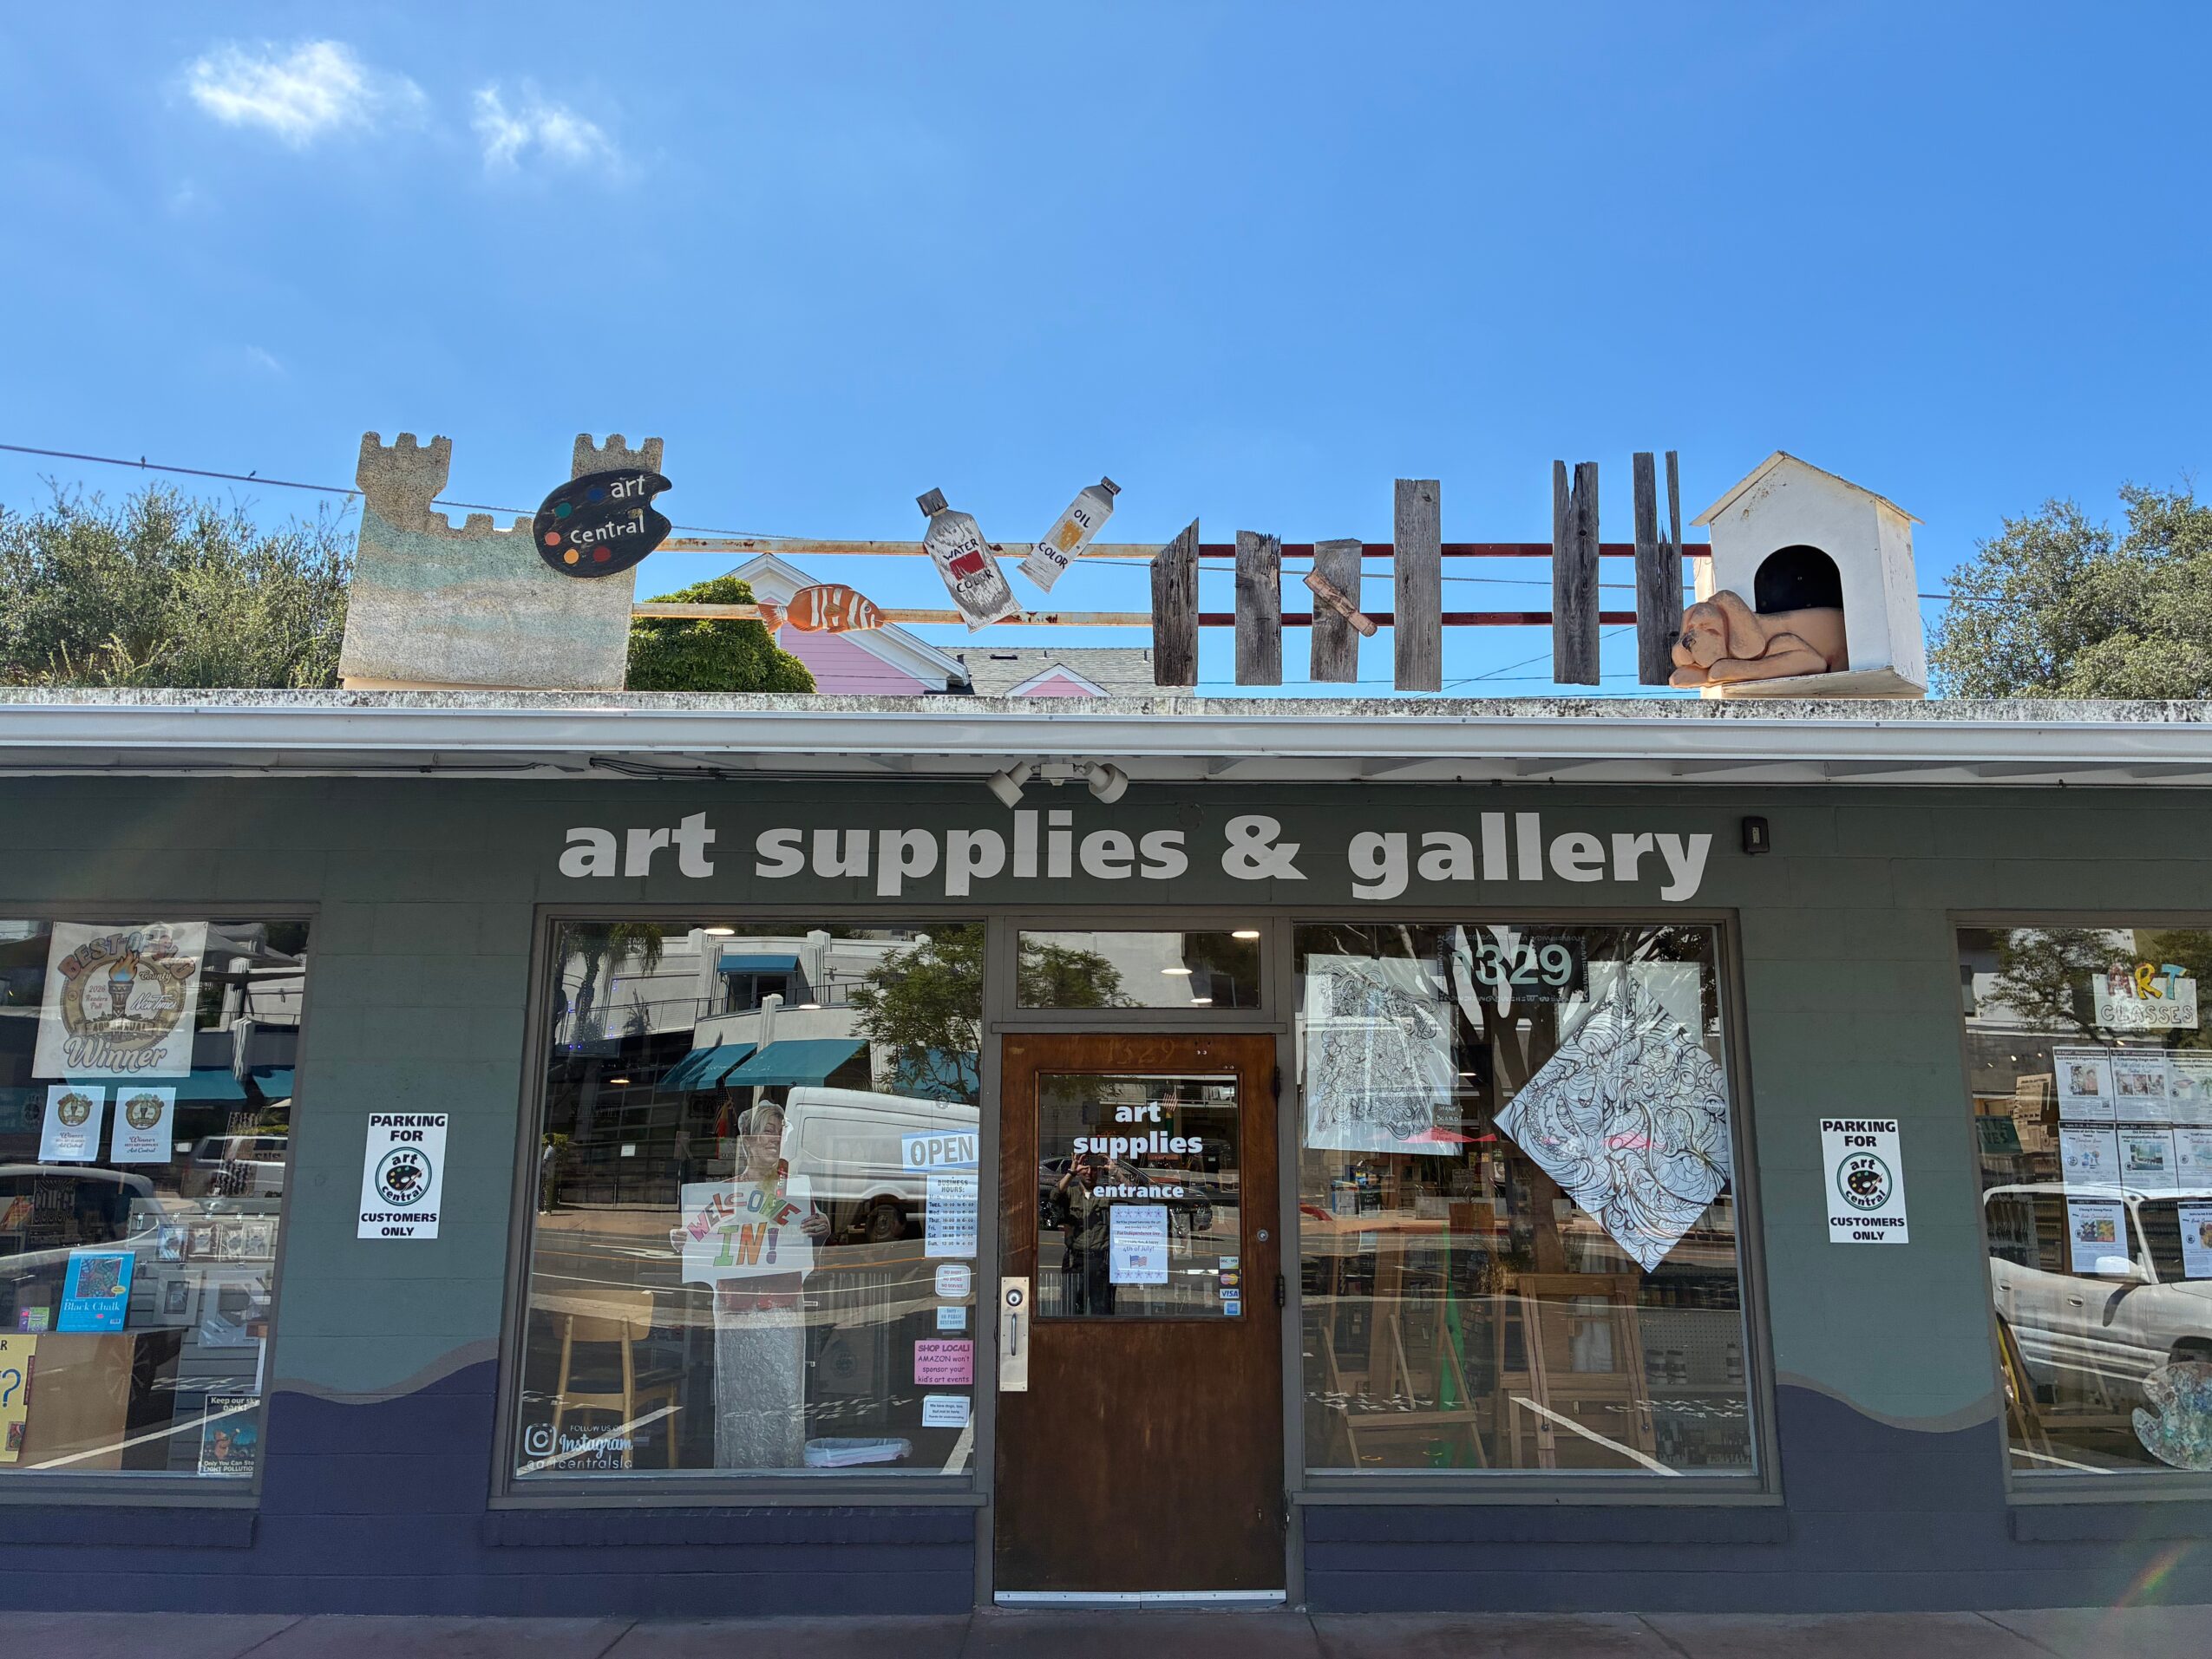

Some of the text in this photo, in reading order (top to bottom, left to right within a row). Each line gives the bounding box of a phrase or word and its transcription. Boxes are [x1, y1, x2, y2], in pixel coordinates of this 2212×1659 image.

[611, 474, 645, 499] art
[1074, 509, 1090, 528] OIL
[570, 512, 645, 544] central
[943, 539, 979, 561] WATER
[1038, 542, 1069, 569] COLOR
[956, 569, 994, 593] COLOR
[558, 809, 1713, 902] art supplies & gallery
[57, 933, 123, 981] BEST
[1451, 944, 1572, 986] 1329
[139, 970, 172, 983] County
[2106, 963, 2188, 1001] ART
[88, 984, 106, 993] 2026
[130, 992, 154, 1010] New
[2100, 1004, 2194, 1025] CLASSES
[92, 1022, 110, 1032] 40th
[63, 1035, 168, 1074] Winner
[370, 1115, 445, 1127] PARKING
[1115, 1101, 1161, 1123] art
[1823, 1120, 1896, 1133] PARKING
[389, 1130, 423, 1142] FOR
[1073, 1130, 1203, 1159] supplies
[1844, 1135, 1877, 1147] FOR
[391, 1153, 418, 1166] art
[910, 1135, 974, 1166] OPEN
[1849, 1159, 1875, 1171] art
[382, 1185, 423, 1202] central
[1093, 1183, 1185, 1199] entrance
[1845, 1189, 1886, 1207] central
[361, 1212, 437, 1223] CUSTOMERS
[686, 1189, 802, 1243] WELCOME
[1830, 1217, 1905, 1227] CUSTOMERS
[381, 1227, 415, 1237] ONLY
[1852, 1231, 1885, 1241] ONLY
[713, 1221, 780, 1268] IN!
[64, 1302, 120, 1311] Black Chalk
[559, 1433, 634, 1460] Instagram
